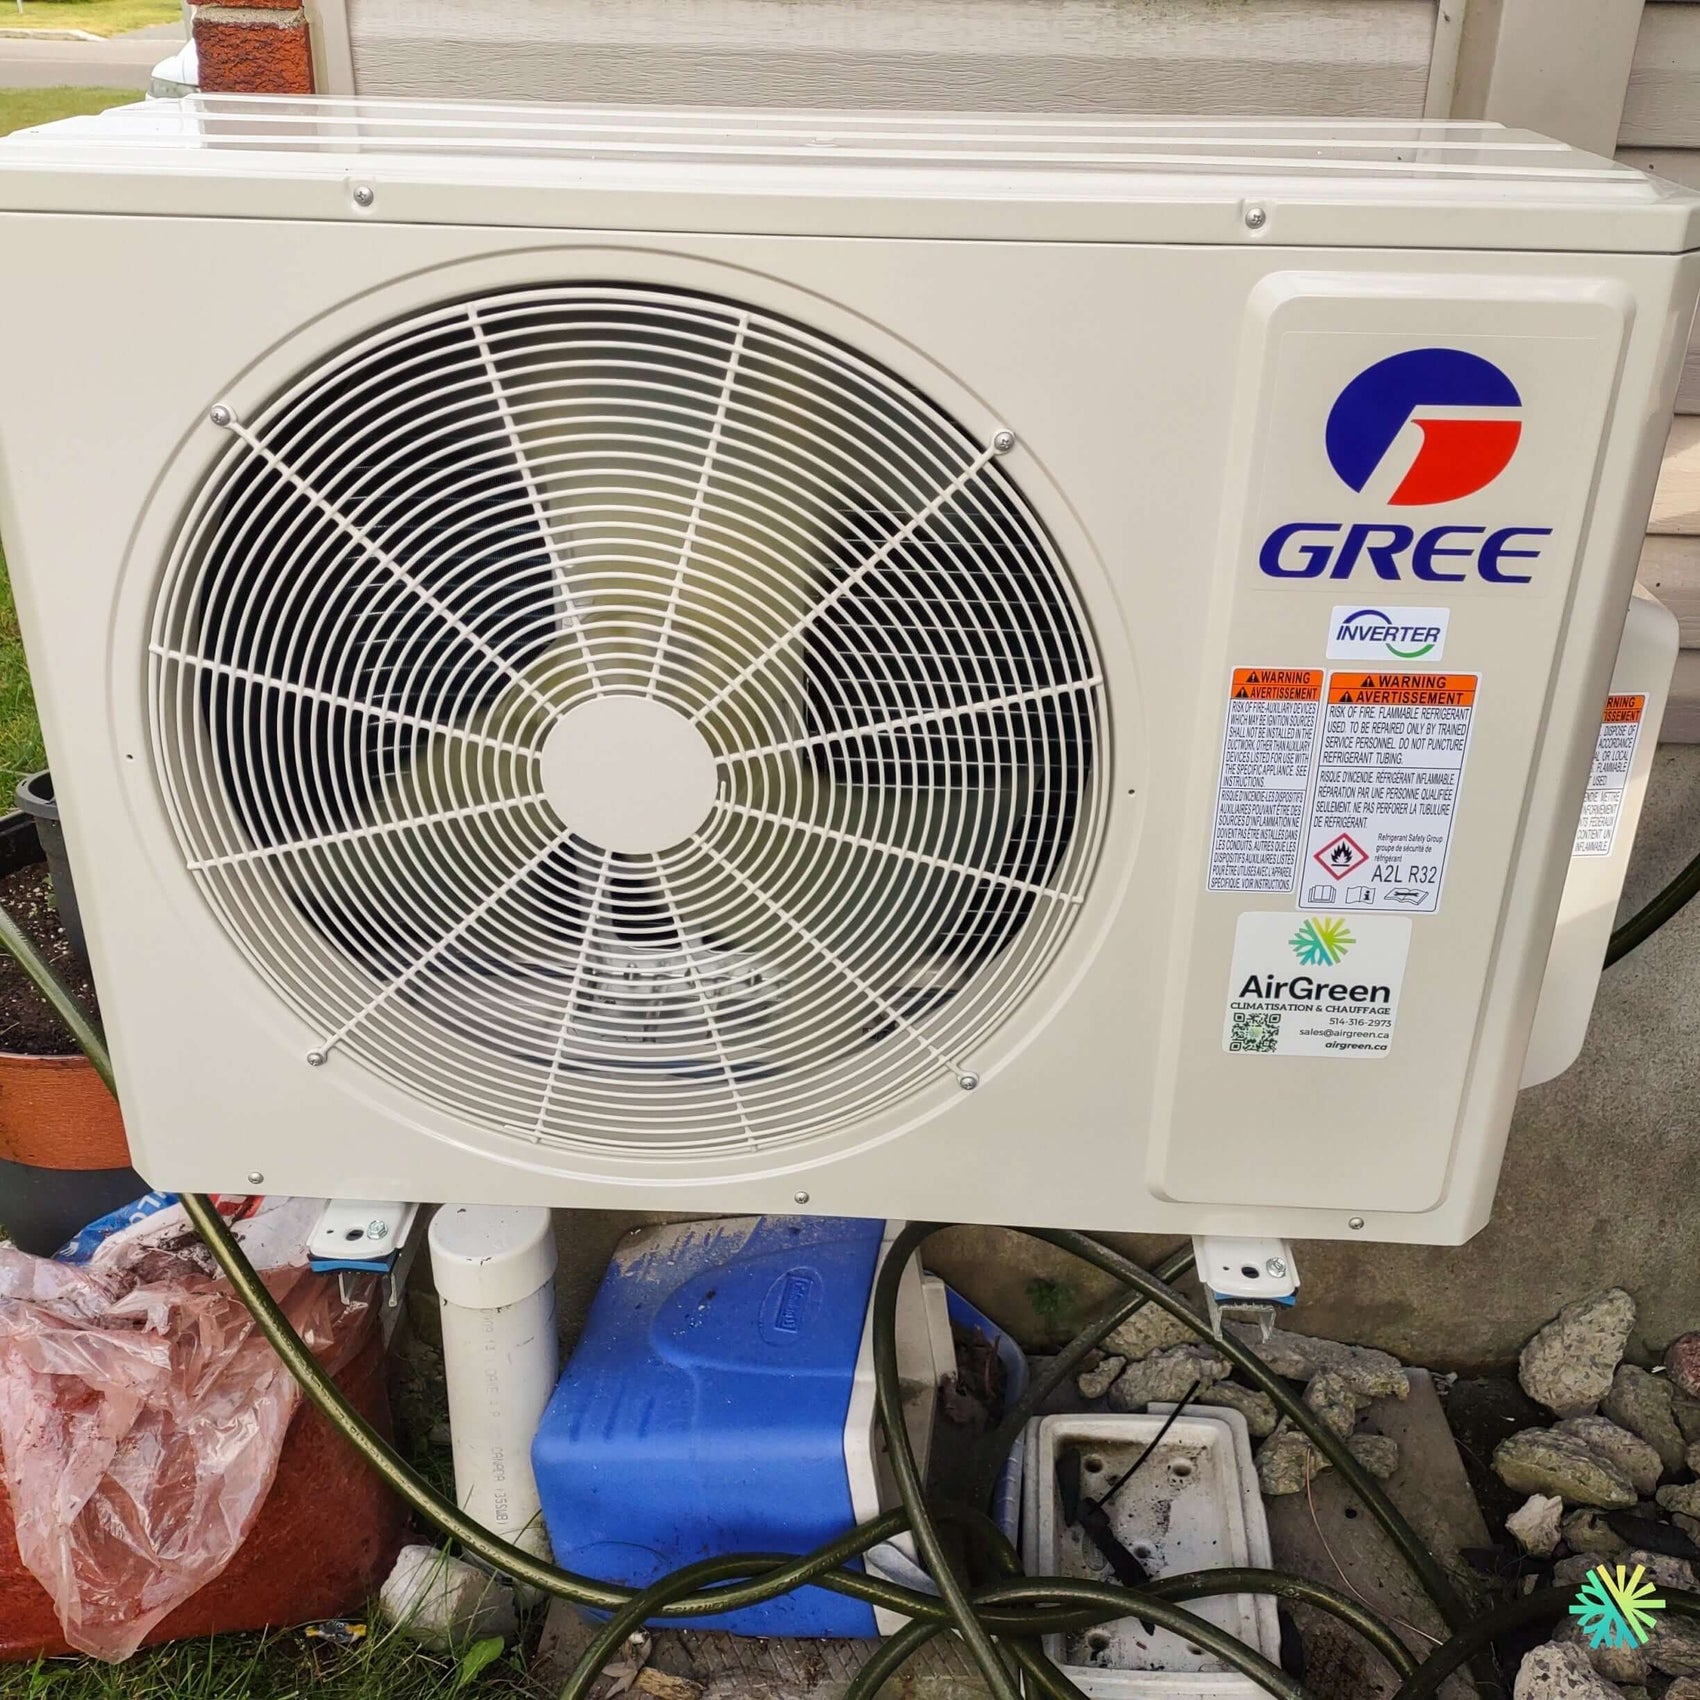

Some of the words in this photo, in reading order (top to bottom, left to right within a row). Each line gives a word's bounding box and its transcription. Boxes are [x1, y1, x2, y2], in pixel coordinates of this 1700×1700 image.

[1258, 522, 1554, 584] GREE
[1336, 624, 1441, 643] INVERTER
[1260, 671, 1311, 684] WARNING
[1378, 676, 1447, 688] WARNING
[1250, 686, 1317, 699] AVERTISSEMENT
[1356, 690, 1464, 704] AVERTISSEMENT
[1232, 701, 1244, 712] RISK
[1293, 703, 1316, 714] DEVICES
[1606, 697, 1635, 708] RNING
[1329, 706, 1345, 718] RISK
[1348, 706, 1357, 718] OF
[1378, 707, 1420, 719] FLAMMABLE
[1420, 708, 1469, 720] REFRIGERANT
[1604, 711, 1640, 721] ISSEMENT
[1231, 714, 1247, 725] WHICH
[1248, 715, 1258, 726] MAY
[1259, 715, 1266, 726] BE
[1267, 715, 1289, 726] IGNITION
[1290, 716, 1314, 727] SOURCES
[1229, 727, 1245, 738] SHALL
[1247, 727, 1258, 739] NOT
[1258, 727, 1266, 739] BE
[1266, 727, 1294, 739] INSTALLED
[1302, 728, 1312, 740] THE
[1350, 722, 1359, 734] TO
[1361, 722, 1370, 734] BE
[1372, 722, 1404, 734] REPAIRED
[1407, 723, 1424, 735] ONLY
[1426, 723, 1435, 735] BY
[1438, 723, 1467, 736] TRAINED
[1604, 725, 1627, 736] DISPOSE
[1628, 725, 1636, 736] OF
[1256, 739, 1273, 751] OTHER
[1274, 740, 1285, 751] THAN
[1286, 740, 1310, 752] AUXILIARY
[1325, 736, 1353, 749] SERVICE
[1400, 737, 1409, 750] DO
[1411, 738, 1427, 750] NOT
[1428, 738, 1464, 750] PUNCTURE
[1598, 738, 1633, 748] ACCORDANCE
[1226, 751, 1249, 763] DEVICES
[1250, 752, 1269, 763] LISTED
[1270, 752, 1282, 764] FOR
[1283, 753, 1294, 764] USE
[1295, 753, 1309, 764] WITH
[1323, 751, 1373, 764] REFRIGERANT
[1376, 752, 1403, 764] TUBING.
[1602, 750, 1611, 761] OR
[1612, 750, 1628, 761] LOCAL
[1225, 763, 1236, 775] THE
[1236, 764, 1262, 775] SPECIFIC
[1296, 765, 1308, 776] SEE
[1597, 762, 1627, 772] FLAMMABLE
[1320, 770, 1341, 782] RISQUE
[1221, 790, 1239, 801] RISQUE
[1275, 791, 1303, 803] DISPOSITIFS
[1357, 787, 1369, 799] PAR
[1370, 788, 1384, 799] UNE
[1385, 788, 1419, 800] PERSONNE
[1220, 804, 1251, 815] AUXILIAIRES
[1252, 804, 1276, 815] POUVANT
[1291, 805, 1301, 816] DES
[1352, 802, 1361, 814] NE
[1363, 802, 1374, 814] PAS
[1376, 803, 1408, 815] PERFORER
[1409, 803, 1417, 815] LA
[1419, 803, 1451, 816] TUBULURE
[1219, 815, 1245, 826] SOURCES
[1292, 816, 1300, 828] NE
[1314, 816, 1322, 828] DE
[1217, 828, 1238, 839] DOIVENT
[1238, 828, 1247, 840] PAS
[1285, 829, 1298, 841] DANS
[1378, 833, 1408, 843] Refrigerant
[1409, 834, 1425, 843] Safety
[1427, 834, 1443, 844] Group
[1216, 840, 1225, 851] LES
[1254, 840, 1274, 852] AUTRES
[1275, 841, 1286, 852] QUE
[1287, 841, 1296, 852] LES
[1376, 845, 1394, 853] groupe
[1396, 844, 1402, 852] de
[1214, 853, 1245, 864] DISPOSITIFS
[1246, 853, 1277, 865] AUXILIAIRES
[1212, 865, 1225, 876] POUR
[1256, 866, 1268, 877] AVEC
[1371, 864, 1402, 882] A2L
[1408, 866, 1437, 883] R32
[1242, 878, 1254, 889] VOIR
[1239, 974, 1391, 1003] AirGreen
[1230, 1002, 1313, 1012] CLIMATISATION
[1326, 1006, 1391, 1015] CHAUFFAGE
[1329, 1017, 1392, 1028] 514-316-2973
[1299, 1028, 1390, 1039] sales@airgreen.ca
[1325, 1041, 1388, 1051] airgreen.ca
